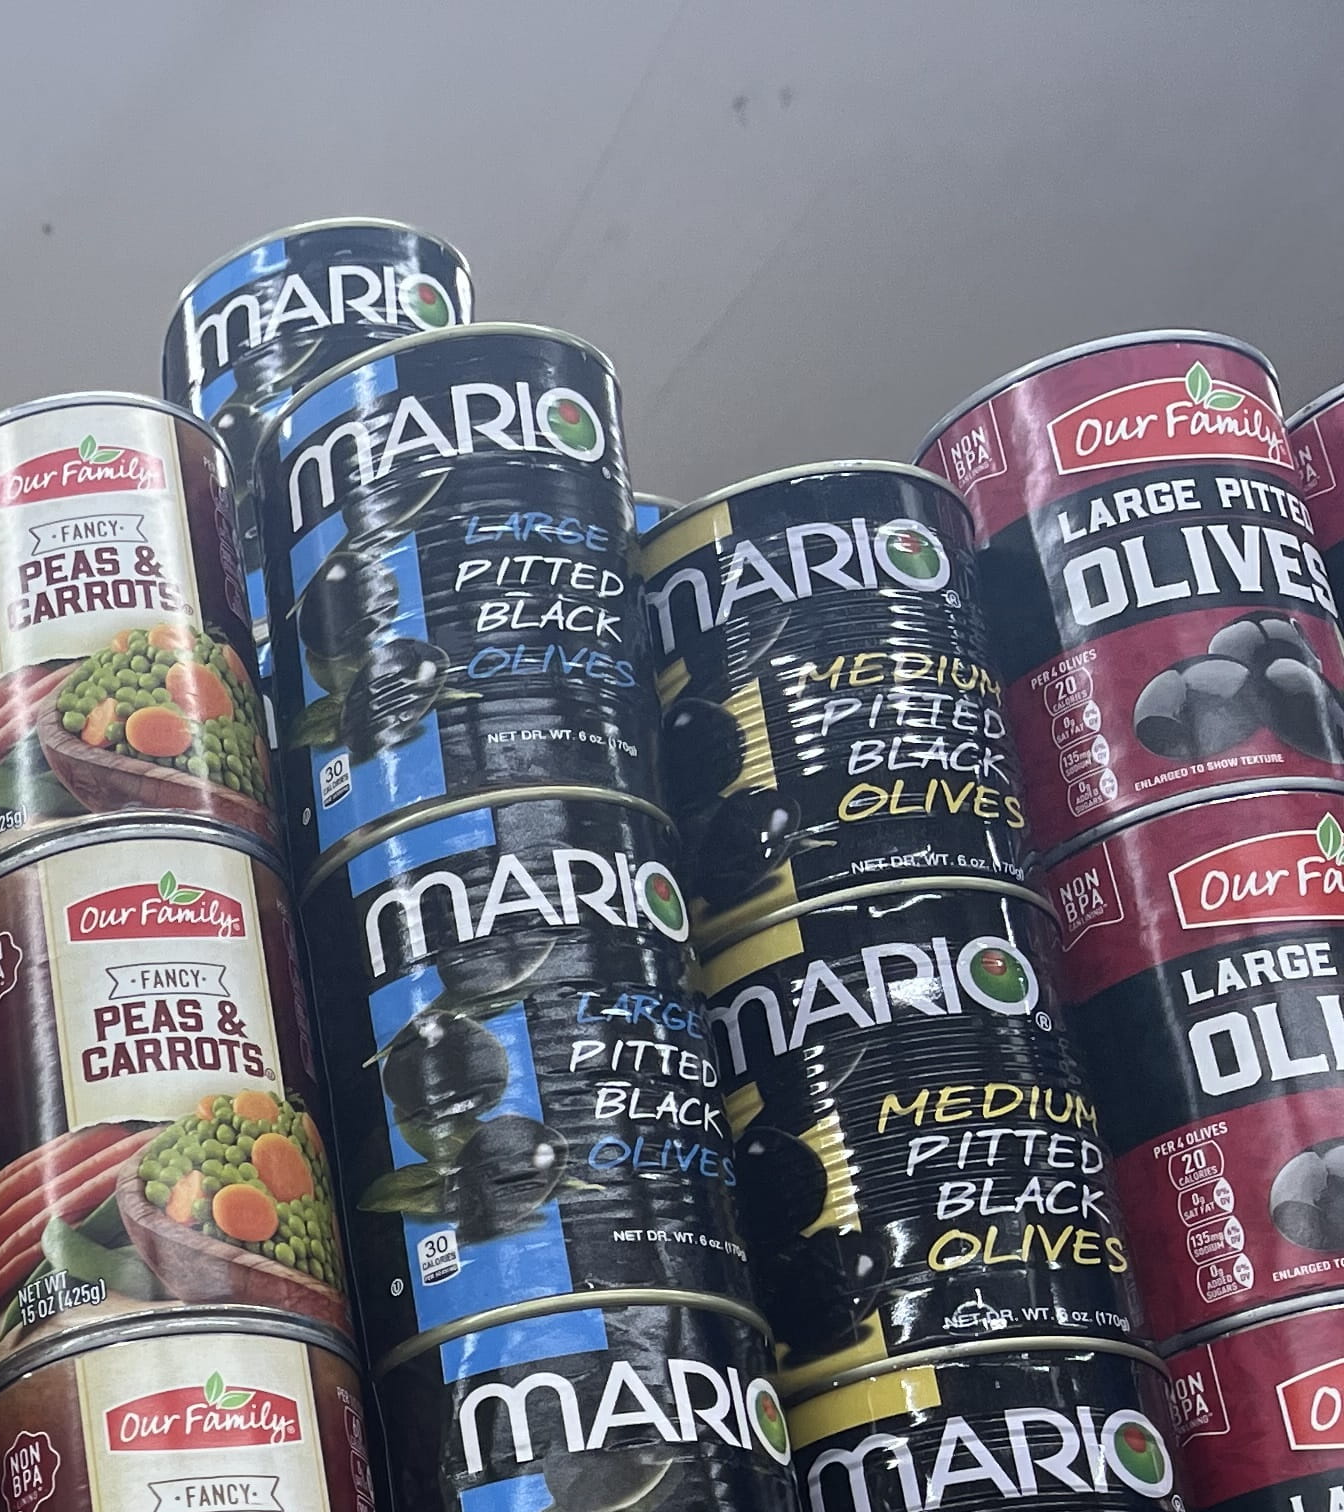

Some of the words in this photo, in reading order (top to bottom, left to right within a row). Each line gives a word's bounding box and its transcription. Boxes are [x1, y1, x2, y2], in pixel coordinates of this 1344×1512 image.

[1076, 416, 1160, 455] Our
[1167, 402, 1283, 461] Family
[1058, 479, 1201, 543] LARGE
[1216, 478, 1314, 534] PITTED
[466, 514, 609, 551] LARGE
[455, 556, 624, 598] PITTED
[1062, 525, 1338, 626] OLIVES
[478, 601, 623, 642] BLACK
[467, 645, 636, 686] OLIVES
[1030, 670, 1051, 689] PER
[1060, 650, 1096, 674] OLIVES
[1055, 678, 1078, 700] 20
[487, 732, 516, 743] NET
[549, 731, 574, 741] WT.
[578, 731, 586, 742] 6
[1135, 769, 1187, 791] ENLARGED
[1190, 765, 1205, 776] TO
[1208, 758, 1237, 773] SHOW
[1240, 754, 1284, 766] TEXTURE
[838, 779, 1026, 829] OLIVES
[1059, 868, 1100, 900] NON
[1064, 893, 1104, 924] BPA
[94, 1001, 203, 1042] PEAS
[218, 1000, 247, 1035] &
[81, 1039, 265, 1083] CARROTS
[906, 1130, 1104, 1176] PITTED
[936, 1181, 1110, 1223] BLACK
[425, 1235, 449, 1256] 30
